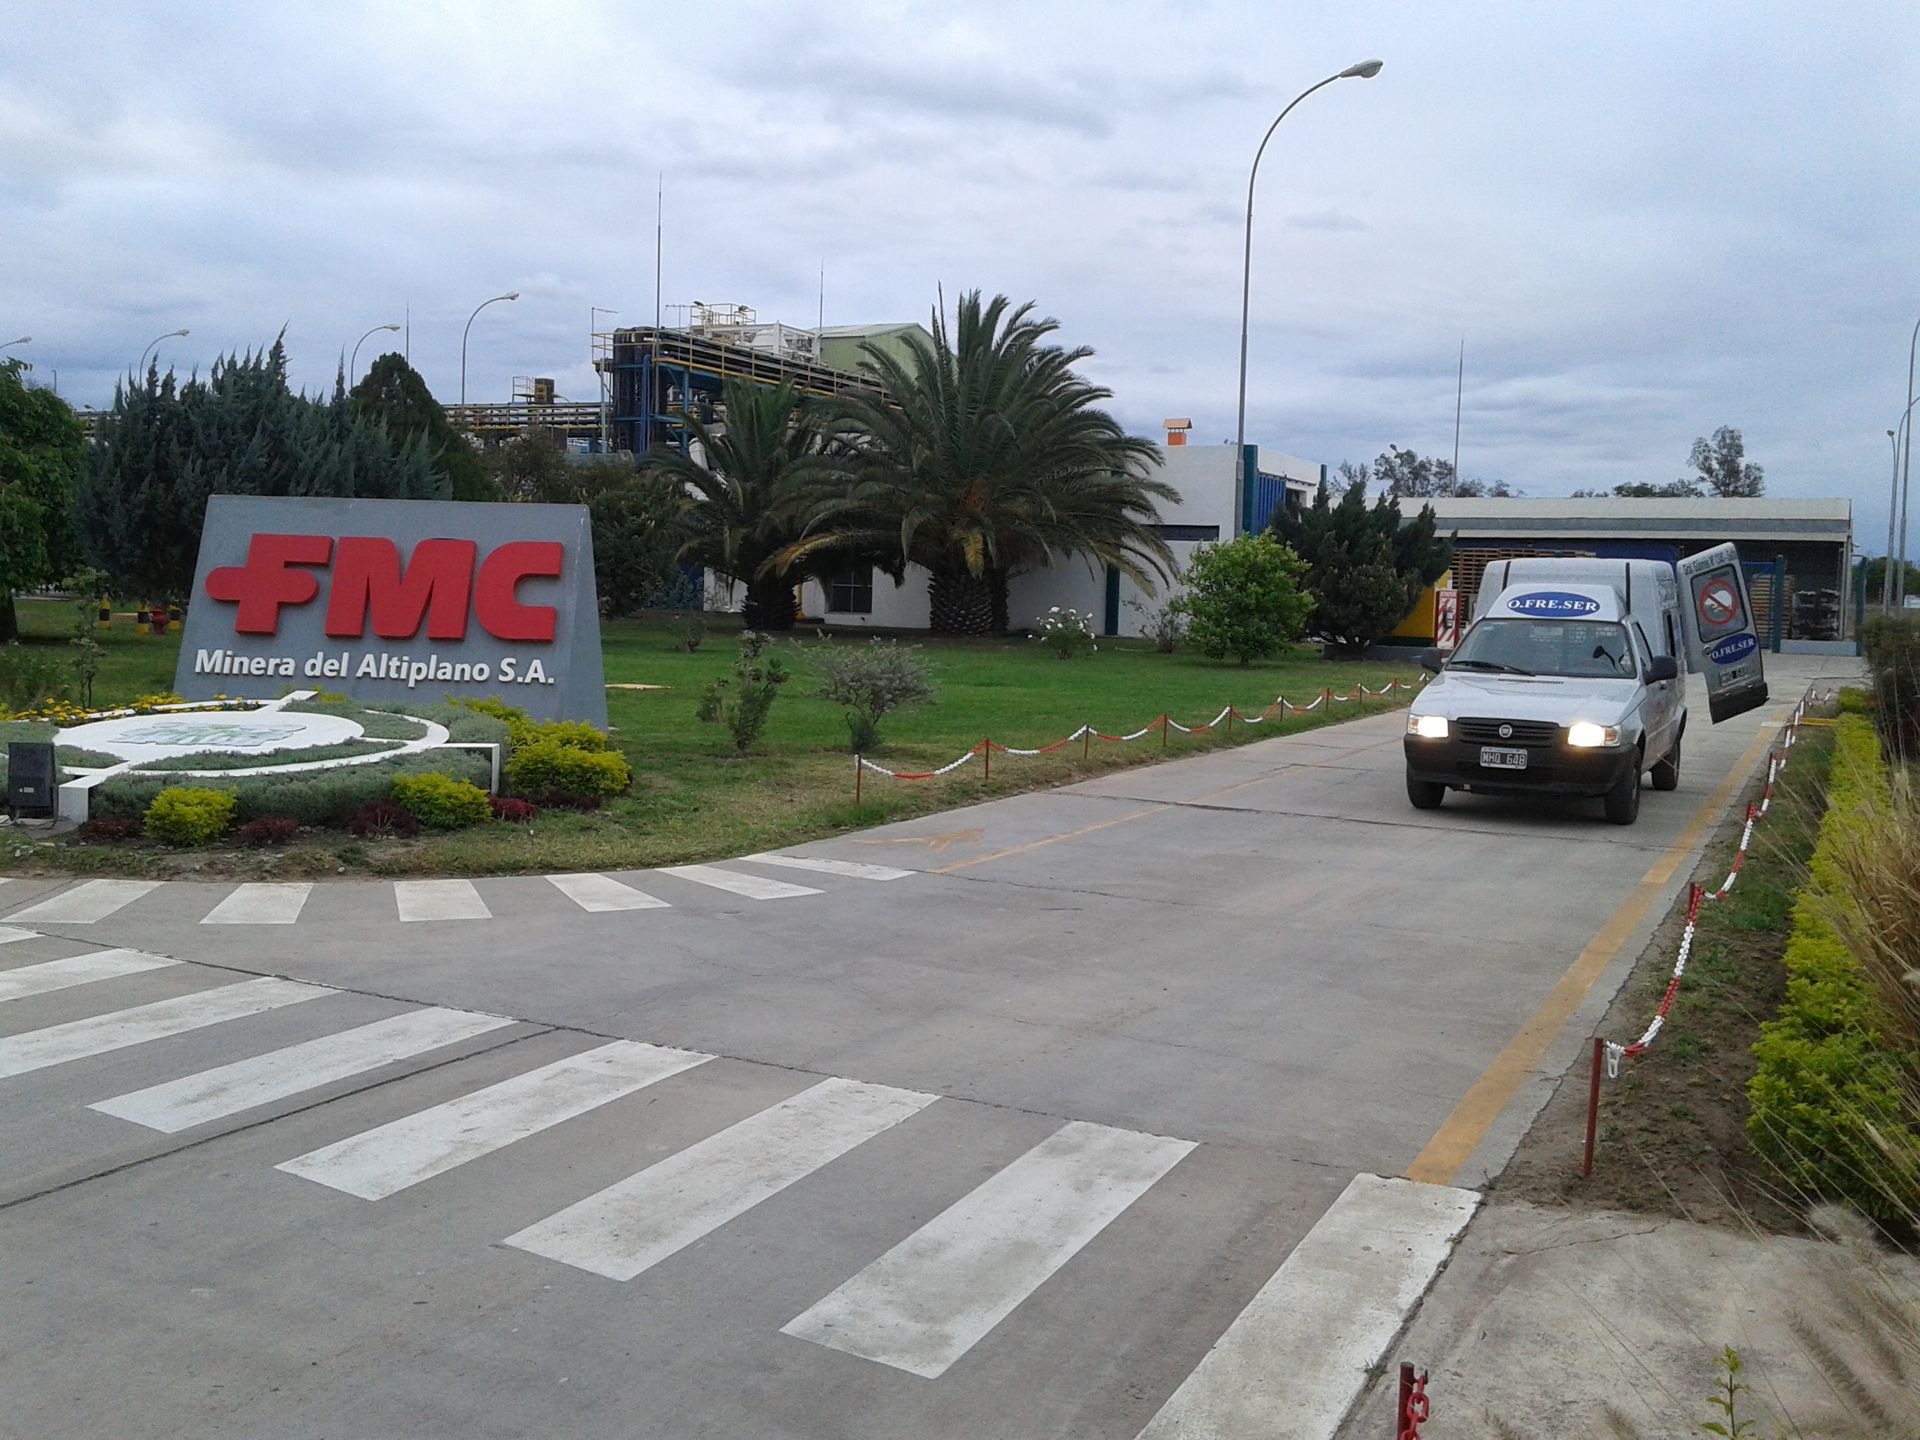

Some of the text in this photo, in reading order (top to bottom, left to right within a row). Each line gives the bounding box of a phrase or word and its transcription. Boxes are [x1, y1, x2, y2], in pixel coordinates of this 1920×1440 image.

[205, 533, 564, 643] FMC
[1507, 599, 1598, 611] O.FRE.SER
[194, 648, 557, 689] Minera del Altiplano S.A.
